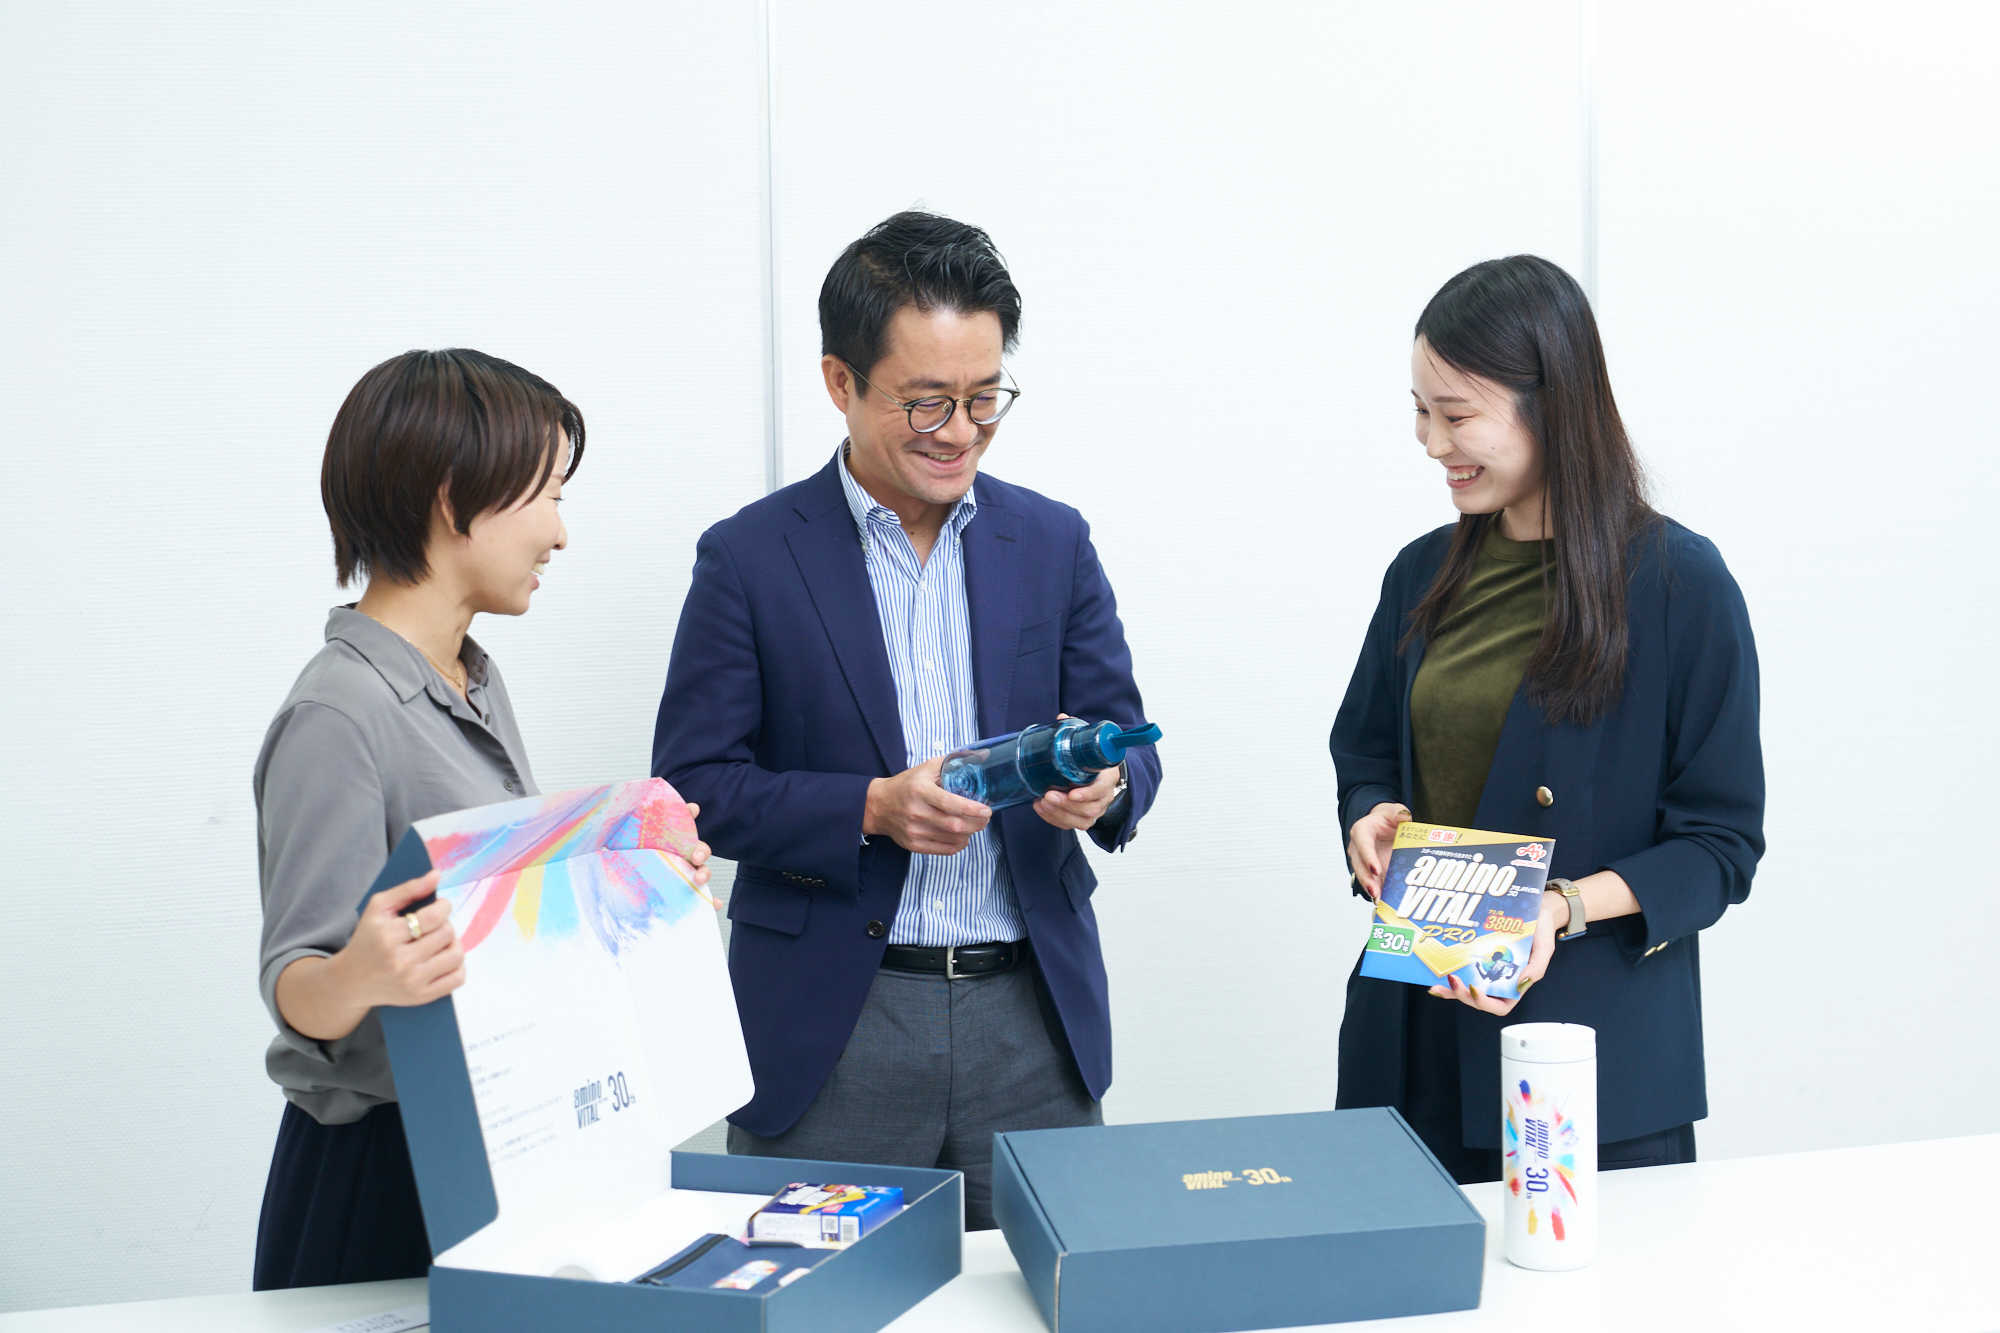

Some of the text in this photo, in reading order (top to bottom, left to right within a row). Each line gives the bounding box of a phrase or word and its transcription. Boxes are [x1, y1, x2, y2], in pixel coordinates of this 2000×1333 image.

[1405, 852, 1517, 897] amino
[1396, 886, 1481, 927] VITAL
[1419, 925, 1477, 943] PRO
[574, 1079, 601, 1109] amino
[577, 1103, 600, 1129] VITAL
[1525, 1118, 1537, 1149] VITAL
[1537, 1119, 1553, 1159] amino
[1182, 1170, 1232, 1183] amino
[1186, 1179, 1228, 1190] VITAL
